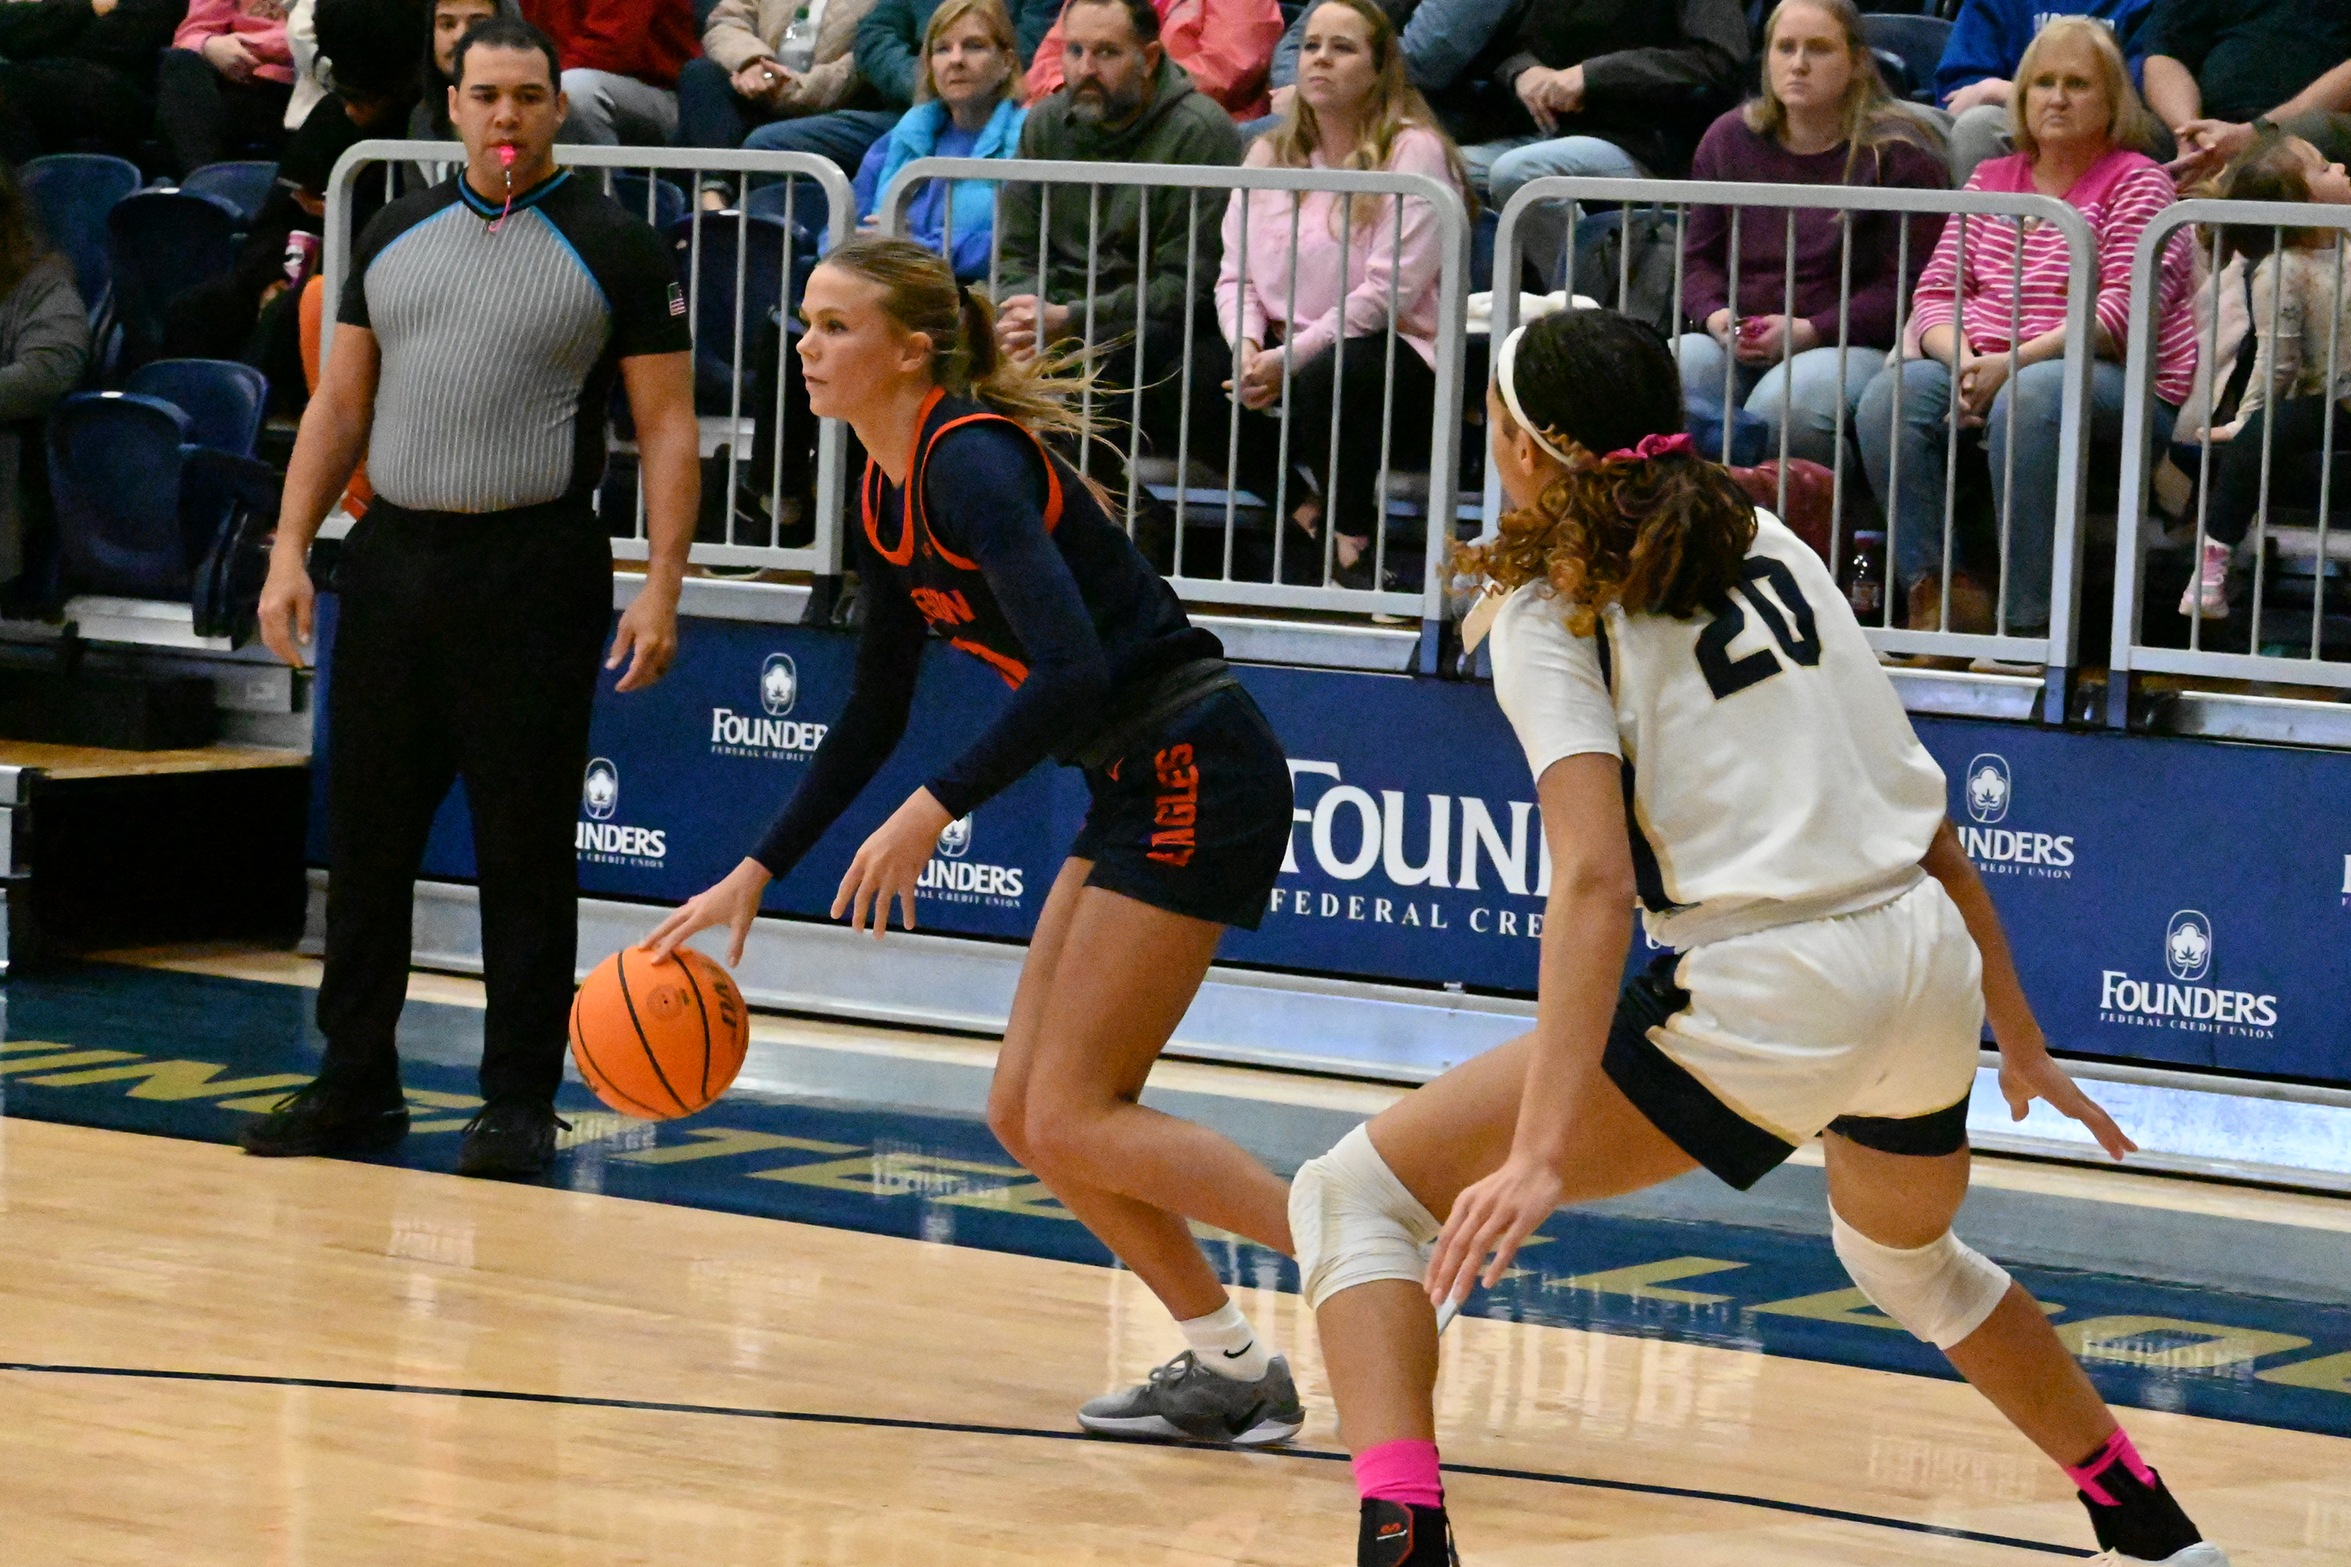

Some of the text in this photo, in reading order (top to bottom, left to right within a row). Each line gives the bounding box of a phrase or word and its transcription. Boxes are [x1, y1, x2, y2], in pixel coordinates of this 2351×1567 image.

[1694, 555, 1822, 701] 20
[1270, 888, 1448, 929] FEDERAL
[2099, 969, 2278, 1027] FOUNDERS
[2100, 1012, 2274, 1040] FEDERAL CREDIT UNION
